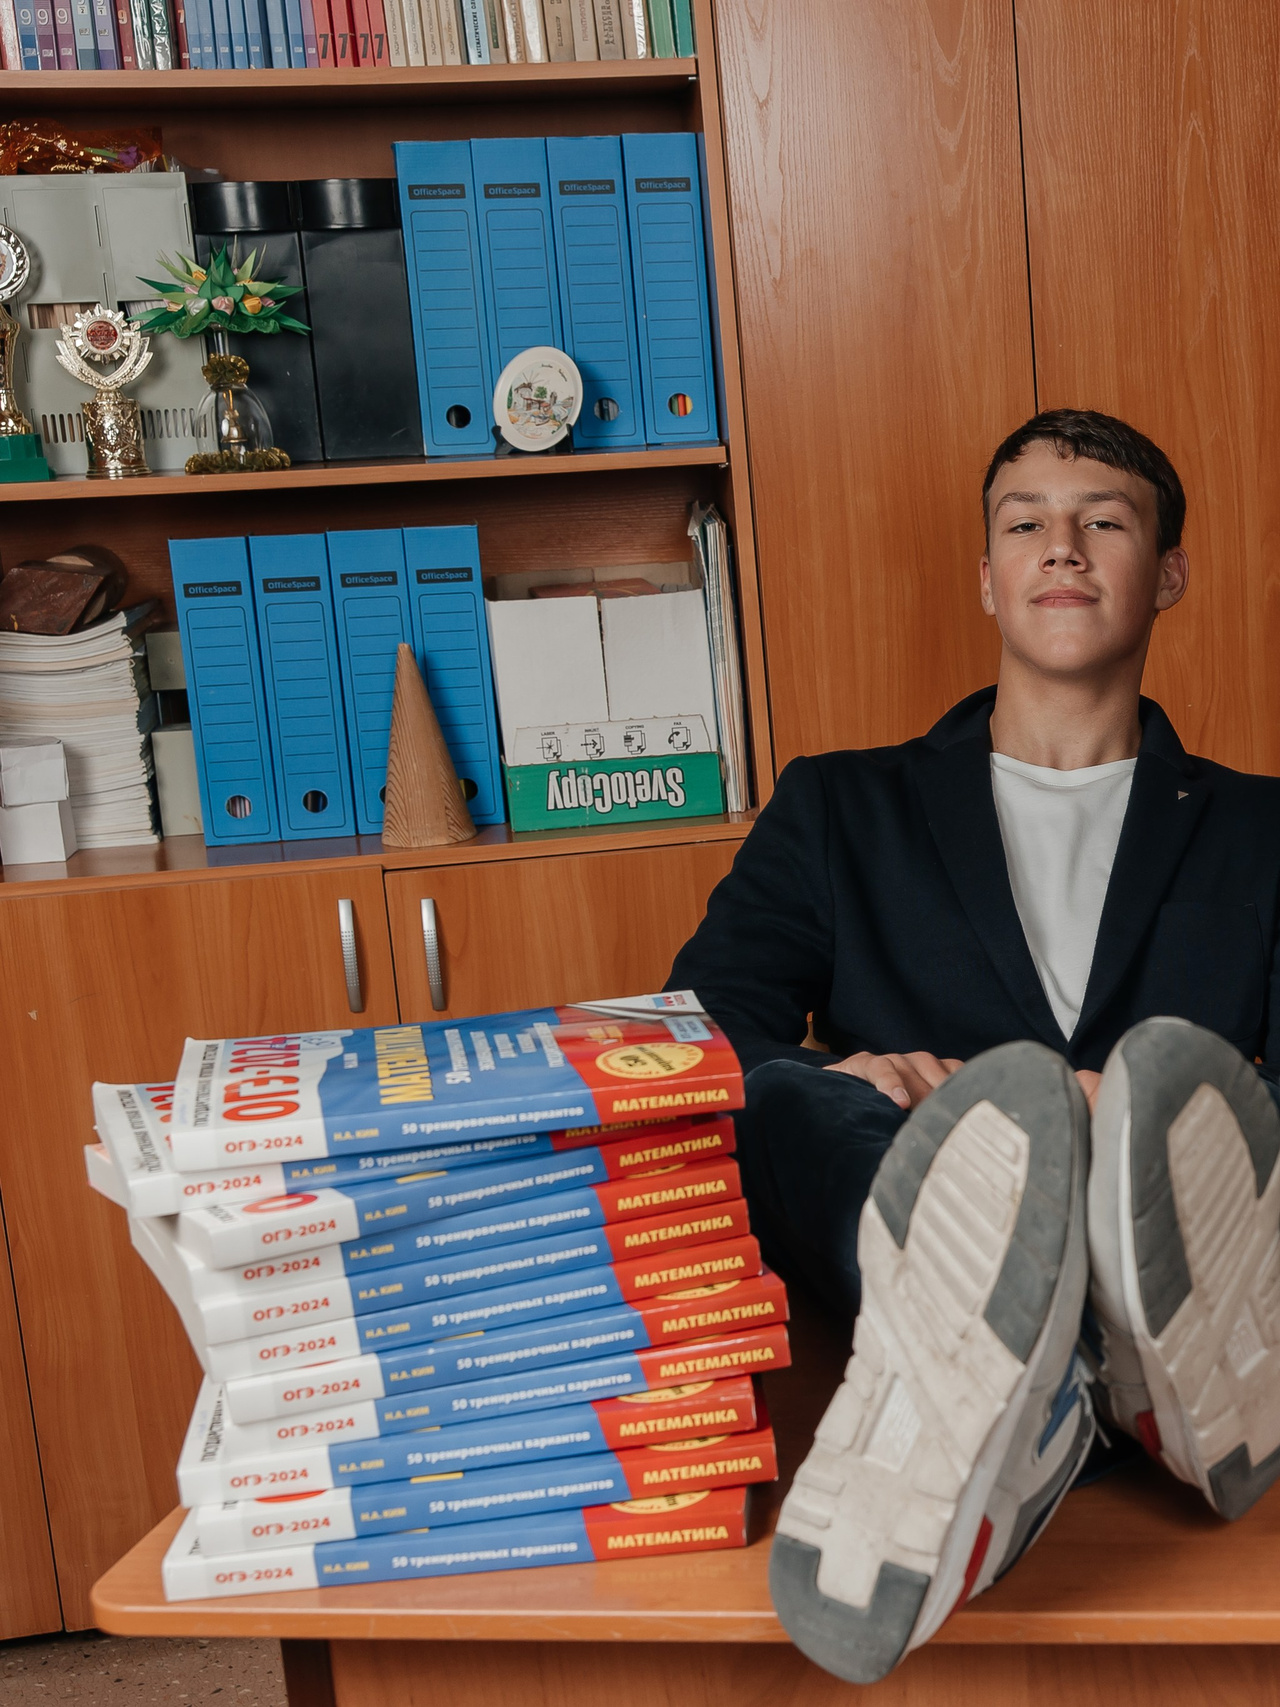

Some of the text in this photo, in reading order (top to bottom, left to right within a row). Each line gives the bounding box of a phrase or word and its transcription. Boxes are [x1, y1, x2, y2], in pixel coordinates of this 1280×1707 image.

[20, 9, 32, 25] 9
[37, 9, 49, 25] 9
[56, 9, 69, 25] 9
[118, 9, 128, 24] 9
[177, 10, 185, 24] 7
[319, 33, 329, 59] 7
[338, 33, 348, 59] 7
[359, 33, 369, 59] 7
[374, 33, 385, 59] 7
[413, 187, 461, 198] OfficeSpace
[488, 186, 536, 196] OfficeSpace
[564, 182, 611, 193] OfficeSpace
[640, 180, 687, 191] OfficeSpace
[268, 580, 316, 591] OfficeSpace
[345, 574, 393, 586] OfficeSpace
[421, 570, 468, 582] OfficeSpace
[188, 584, 237, 596] OfficeSpace
[547, 766, 686, 814] SvetoCopy
[222, 1036, 301, 1121] ОГЭ-2024
[225, 1136, 303, 1152] ОГЭ-2024
[402, 1123, 417, 1134] 50
[421, 1112, 517, 1133] тренировочных
[520, 1106, 584, 1122] вариантов
[613, 1089, 728, 1112] МАТЕМАТИКА
[184, 1134, 536, 1195] ОГЭ-2024 50 тренировочных вариантов
[262, 1220, 336, 1244] ОГЭ-2024
[428, 1196, 442, 1208] 50
[445, 1178, 534, 1205] тренировочных
[535, 1165, 594, 1185] вариантов
[620, 1135, 722, 1167] МАТЕМАТИКА
[244, 1180, 726, 1280] ОГЭ-2024 50 тренировочных вариантов МАТЕМАТИКА
[253, 1298, 329, 1321] ОГЭ-2024
[425, 1275, 440, 1287] 50
[442, 1258, 535, 1284] тренировочных
[536, 1245, 598, 1264] вариантов
[625, 1215, 733, 1247] МАТЕМАТИКА
[260, 1256, 745, 1360] ОГЭ-2024 50 тренировочных вариантов МАТЕМАТИКА
[283, 1302, 774, 1402] ОГЭ-2024 50 тренировочных вариантов МАТЕМАТИКА
[277, 1347, 774, 1439] ОГЭ-2024 50 тренировочных вариантов МАТЕМАТИКА
[230, 1409, 738, 1488] ОГЭ-2024 50 тренировочных вариантов МАТЕМАТИКА
[252, 1456, 762, 1536] ОГЭ-2024 50 тренировочных вариантов МАТЕМАТИКА
[215, 1526, 728, 1583] ОГЭ-2024 50 тренировочных вариантов МАТЕМАТИКА
